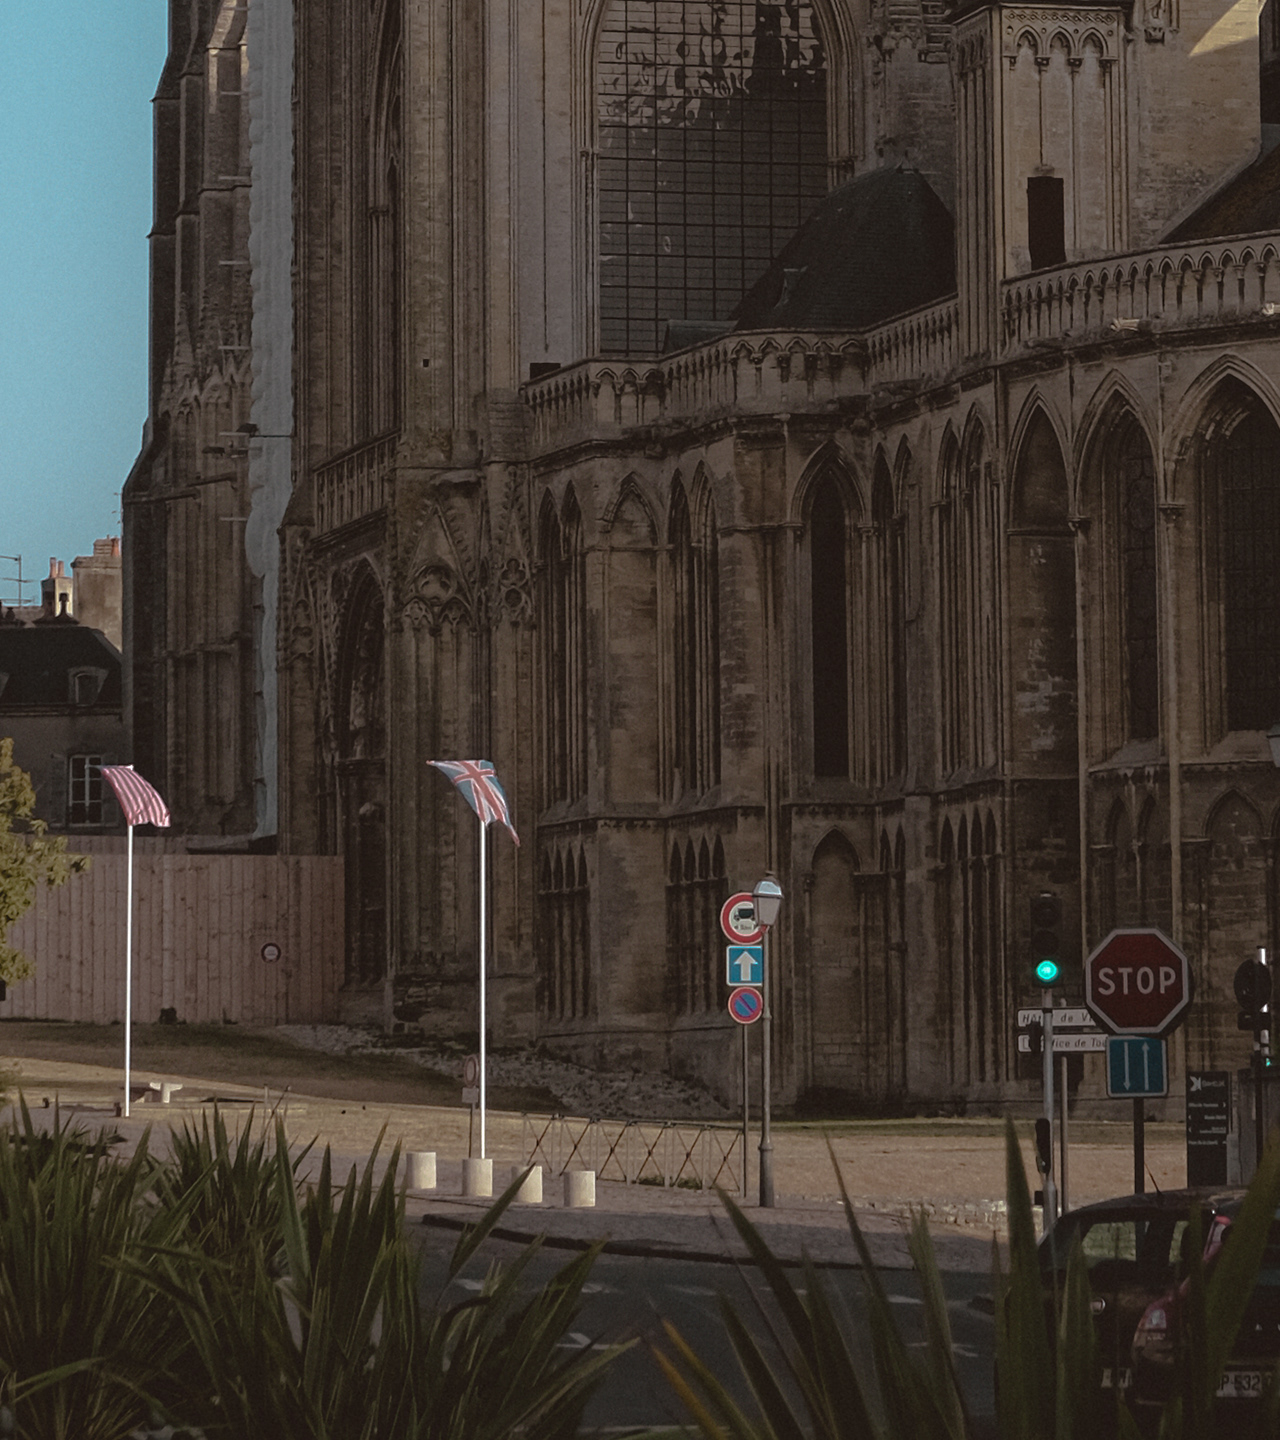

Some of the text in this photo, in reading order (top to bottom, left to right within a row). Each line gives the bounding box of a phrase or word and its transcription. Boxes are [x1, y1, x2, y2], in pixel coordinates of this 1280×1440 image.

[1097, 966, 1177, 995] STOP
[1060, 1013, 1074, 1023] de
[1074, 1037, 1087, 1048] de
